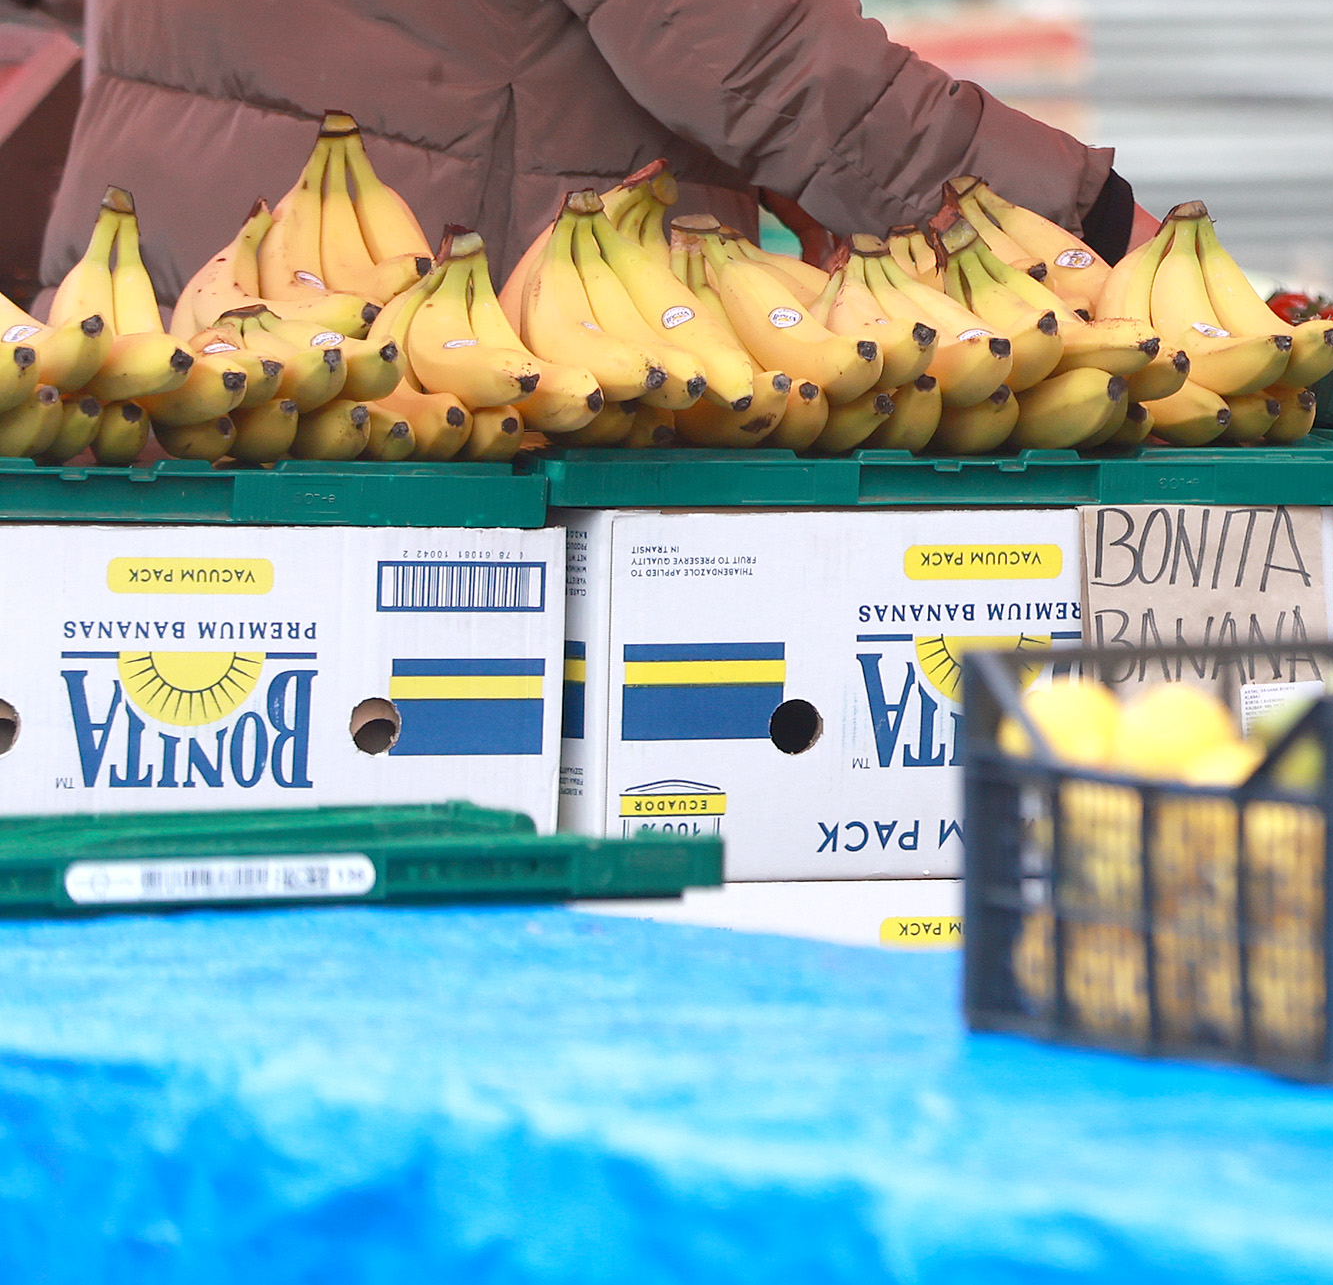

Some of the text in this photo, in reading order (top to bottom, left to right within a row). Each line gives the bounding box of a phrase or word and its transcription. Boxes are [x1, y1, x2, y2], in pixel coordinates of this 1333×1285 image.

[416, 550, 449, 559] 10042
[631, 546, 669, 554] TRANSIT
[1091, 505, 1312, 592] BONITA
[631, 557, 671, 565] QUALITY
[673, 557, 716, 565] PRESERVE
[732, 556, 757, 564] FRUIT
[920, 550, 1042, 566] VACUUM PACK
[128, 568, 256, 583] VACUUM PACK
[630, 568, 753, 577] THIABENDAZOLE APPLIED TO
[858, 602, 1082, 622] REMIUM BANANAS
[63, 621, 318, 640] PREMIUM BANANAS
[1094, 605, 1325, 685] BANANA
[61, 670, 318, 789] BONITA
[634, 800, 707, 811] ECUADOR
[816, 819, 919, 853] PACK
[898, 922, 942, 936] PACK
